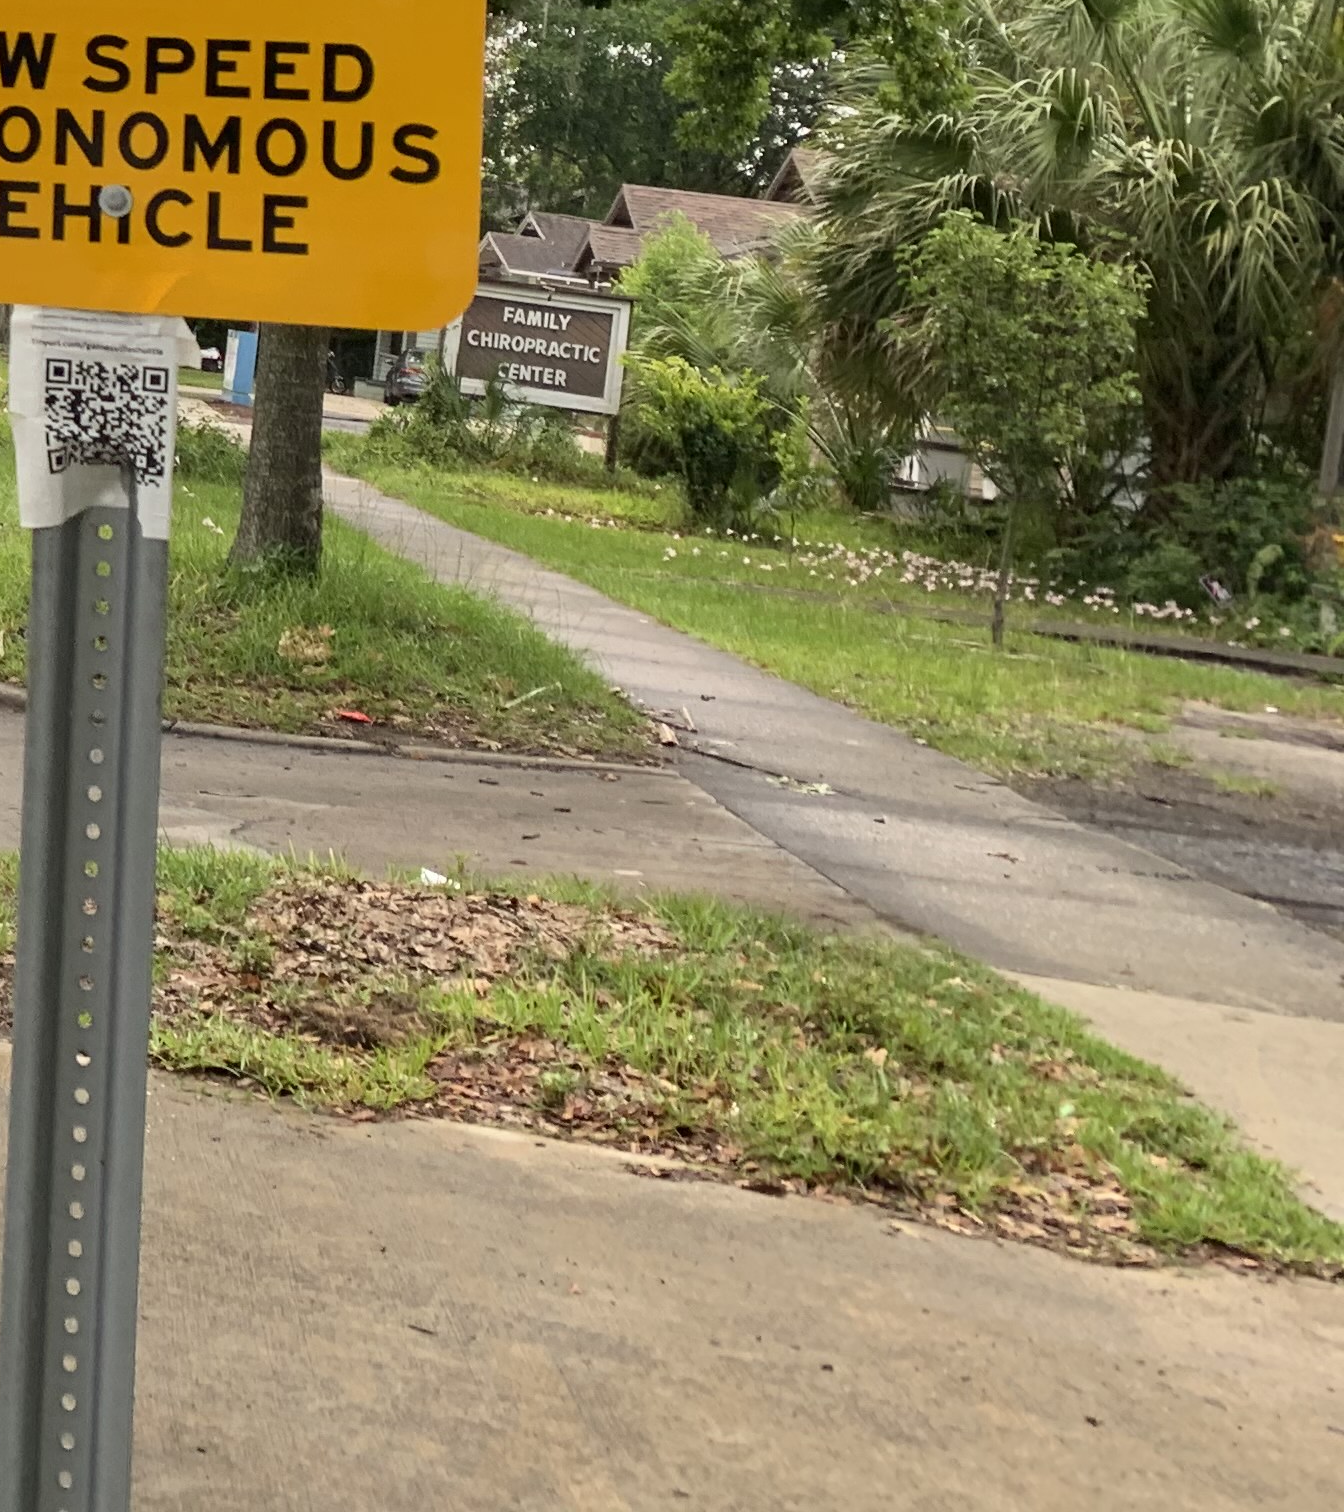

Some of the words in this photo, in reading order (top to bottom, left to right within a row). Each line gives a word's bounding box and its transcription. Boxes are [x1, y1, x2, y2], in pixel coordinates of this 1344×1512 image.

[84, 35, 375, 103] SPEED
[503, 306, 572, 331] FAMILY
[467, 329, 601, 364] CHIROPRACTIC
[498, 362, 567, 387] CENTER
